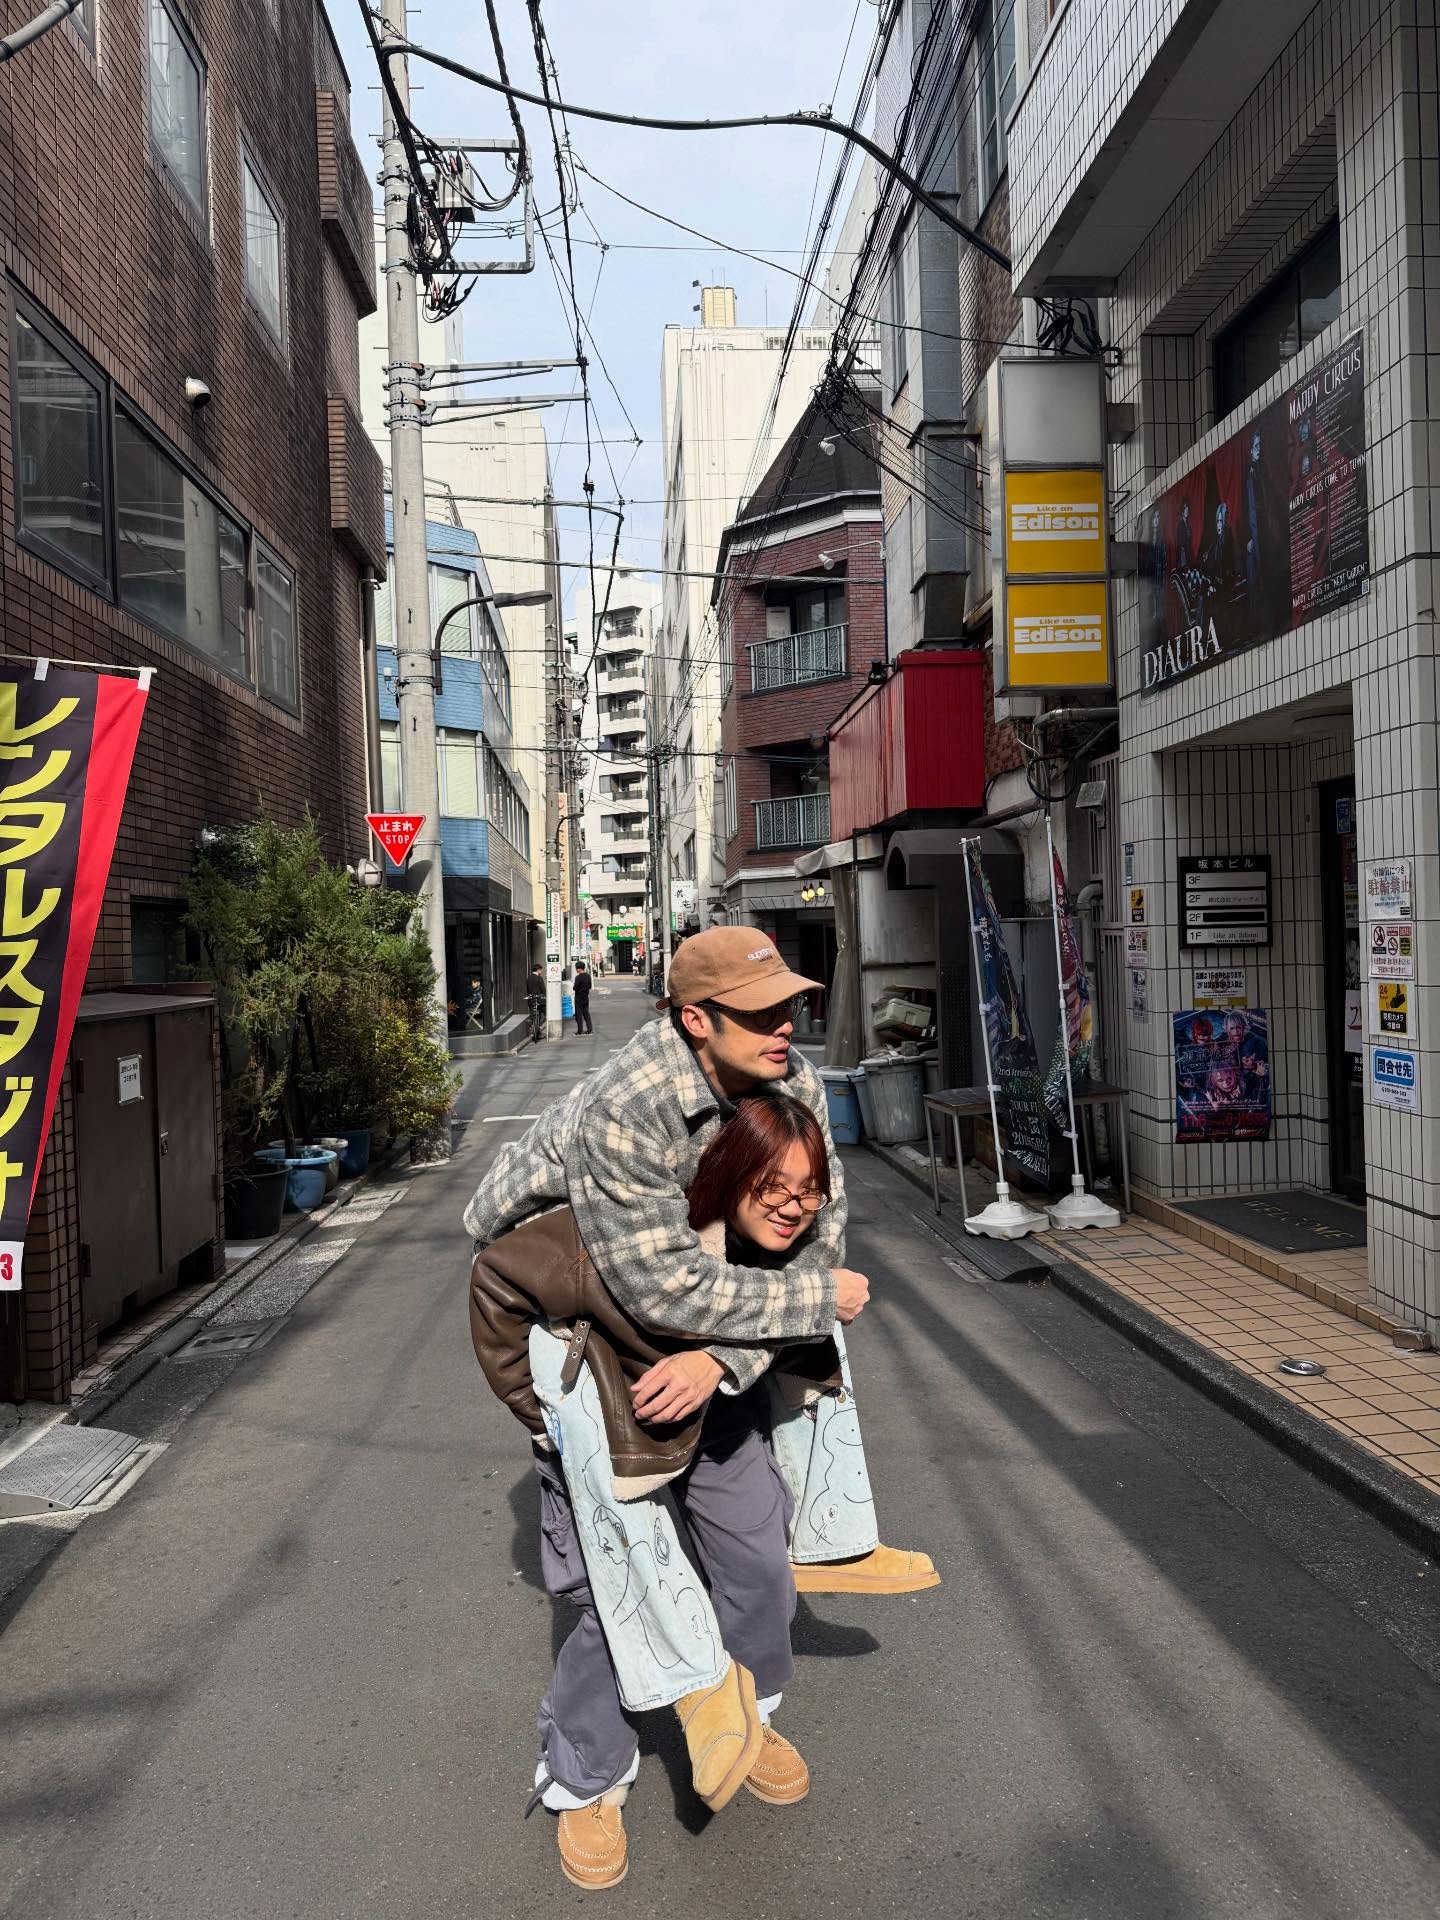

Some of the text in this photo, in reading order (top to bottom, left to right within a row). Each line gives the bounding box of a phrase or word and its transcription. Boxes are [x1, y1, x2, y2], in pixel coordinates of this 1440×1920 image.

[1289, 380, 1319, 424] MADDY
[1324, 345, 1361, 395] CIRCUS
[1324, 469, 1339, 488] COME
[1340, 464, 1348, 478] TO
[1349, 451, 1366, 472] TOWN
[1011, 513, 1098, 529] Edison
[1014, 626, 1102, 643] Edison
[1142, 616, 1223, 689] DIAURA
[379, 820, 414, 832] 止まれ
[385, 834, 410, 845] STOP
[1198, 858, 1254, 869] 坂本ビル
[1188, 876, 1201, 885] 3F
[1367, 874, 1410, 896] 駐輪禁止
[1188, 894, 1201, 903] 2F
[1188, 913, 1201, 922] 2F
[1190, 931, 1202, 940] 1F
[1379, 984, 1388, 995] 24
[1377, 1057, 1412, 1078] 問合せ先
